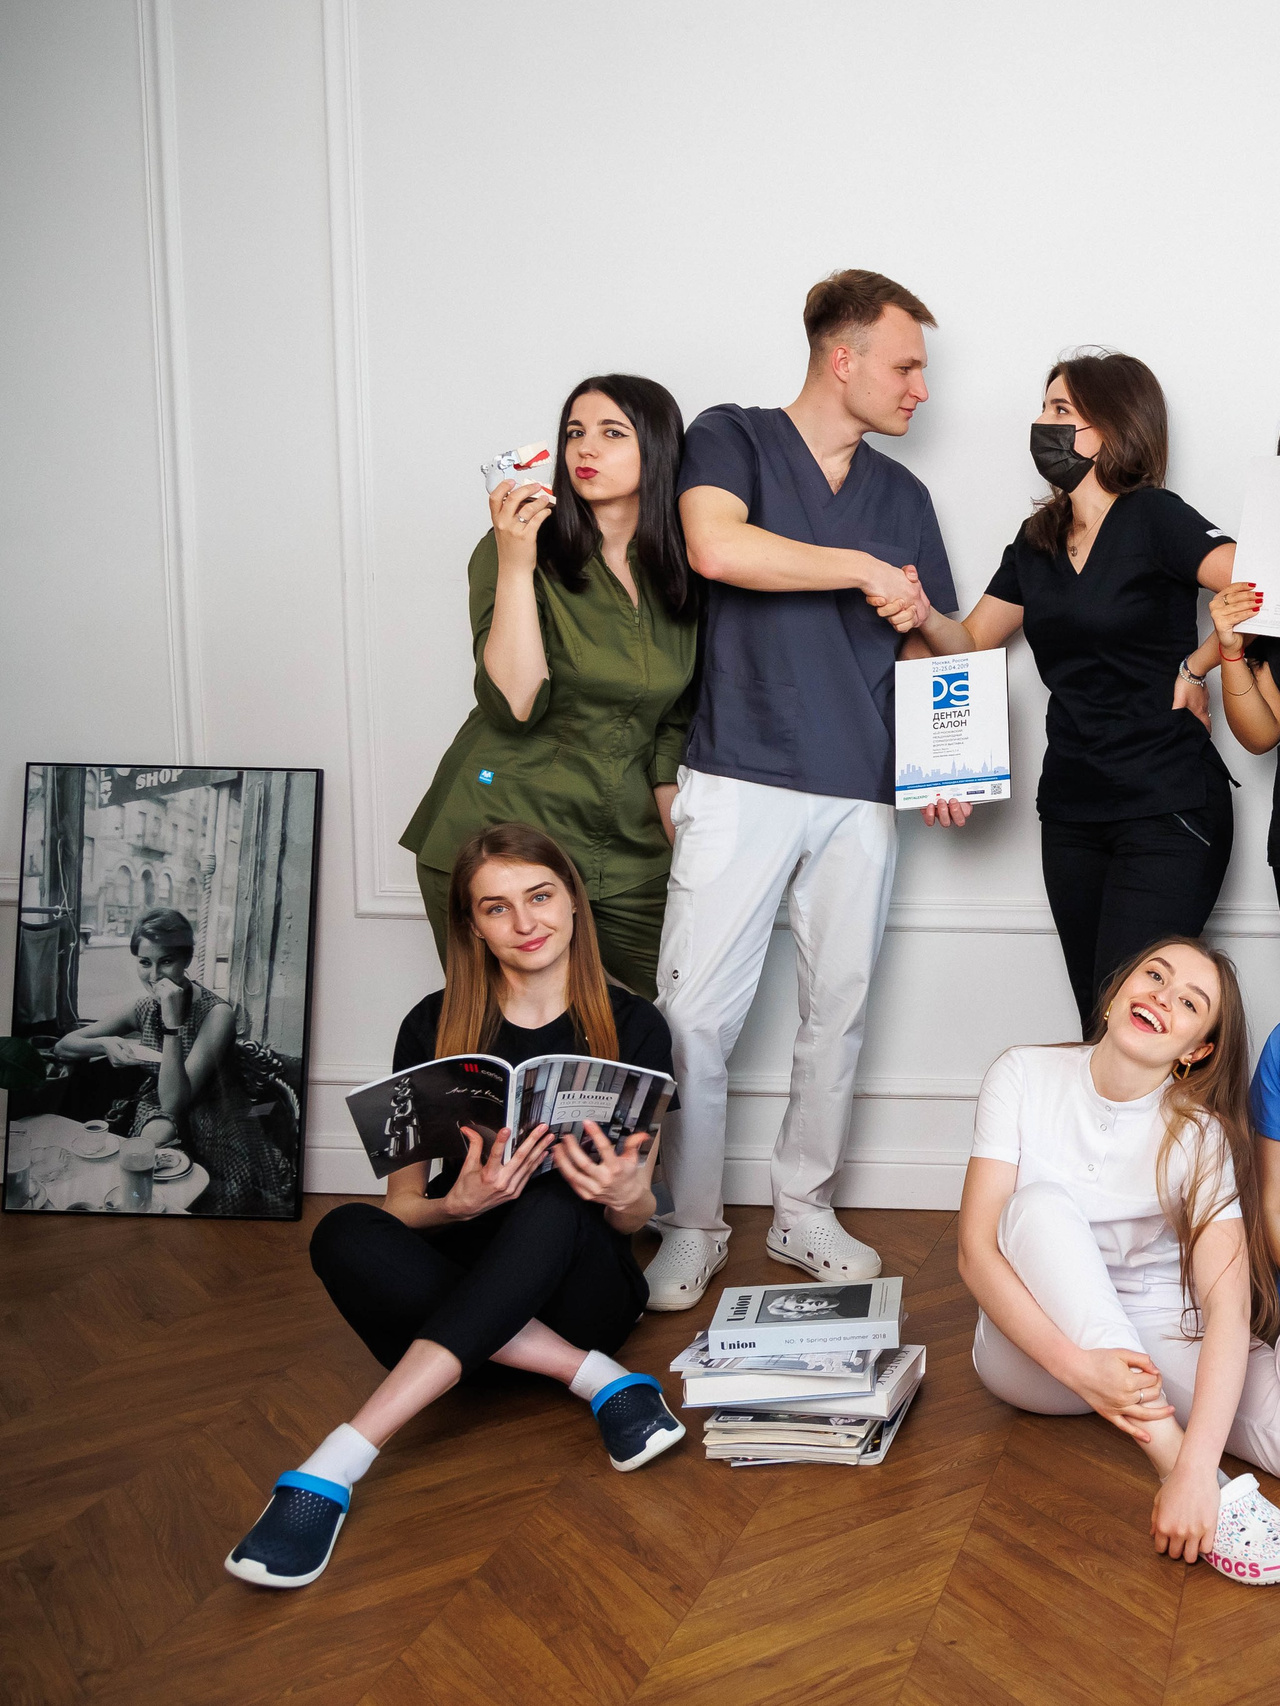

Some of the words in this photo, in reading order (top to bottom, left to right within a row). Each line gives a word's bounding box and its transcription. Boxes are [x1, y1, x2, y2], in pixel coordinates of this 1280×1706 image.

[933, 709, 971, 722] ДЕНТАЛ
[932, 719, 967, 730] САЛОН
[135, 769, 184, 791] SHOP
[561, 1092, 576, 1100] Hi
[579, 1093, 613, 1101] home
[556, 1109, 608, 1121] 2021
[726, 1294, 753, 1322] Union
[720, 1340, 756, 1351] Union
[1205, 1551, 1261, 1578] crocs
